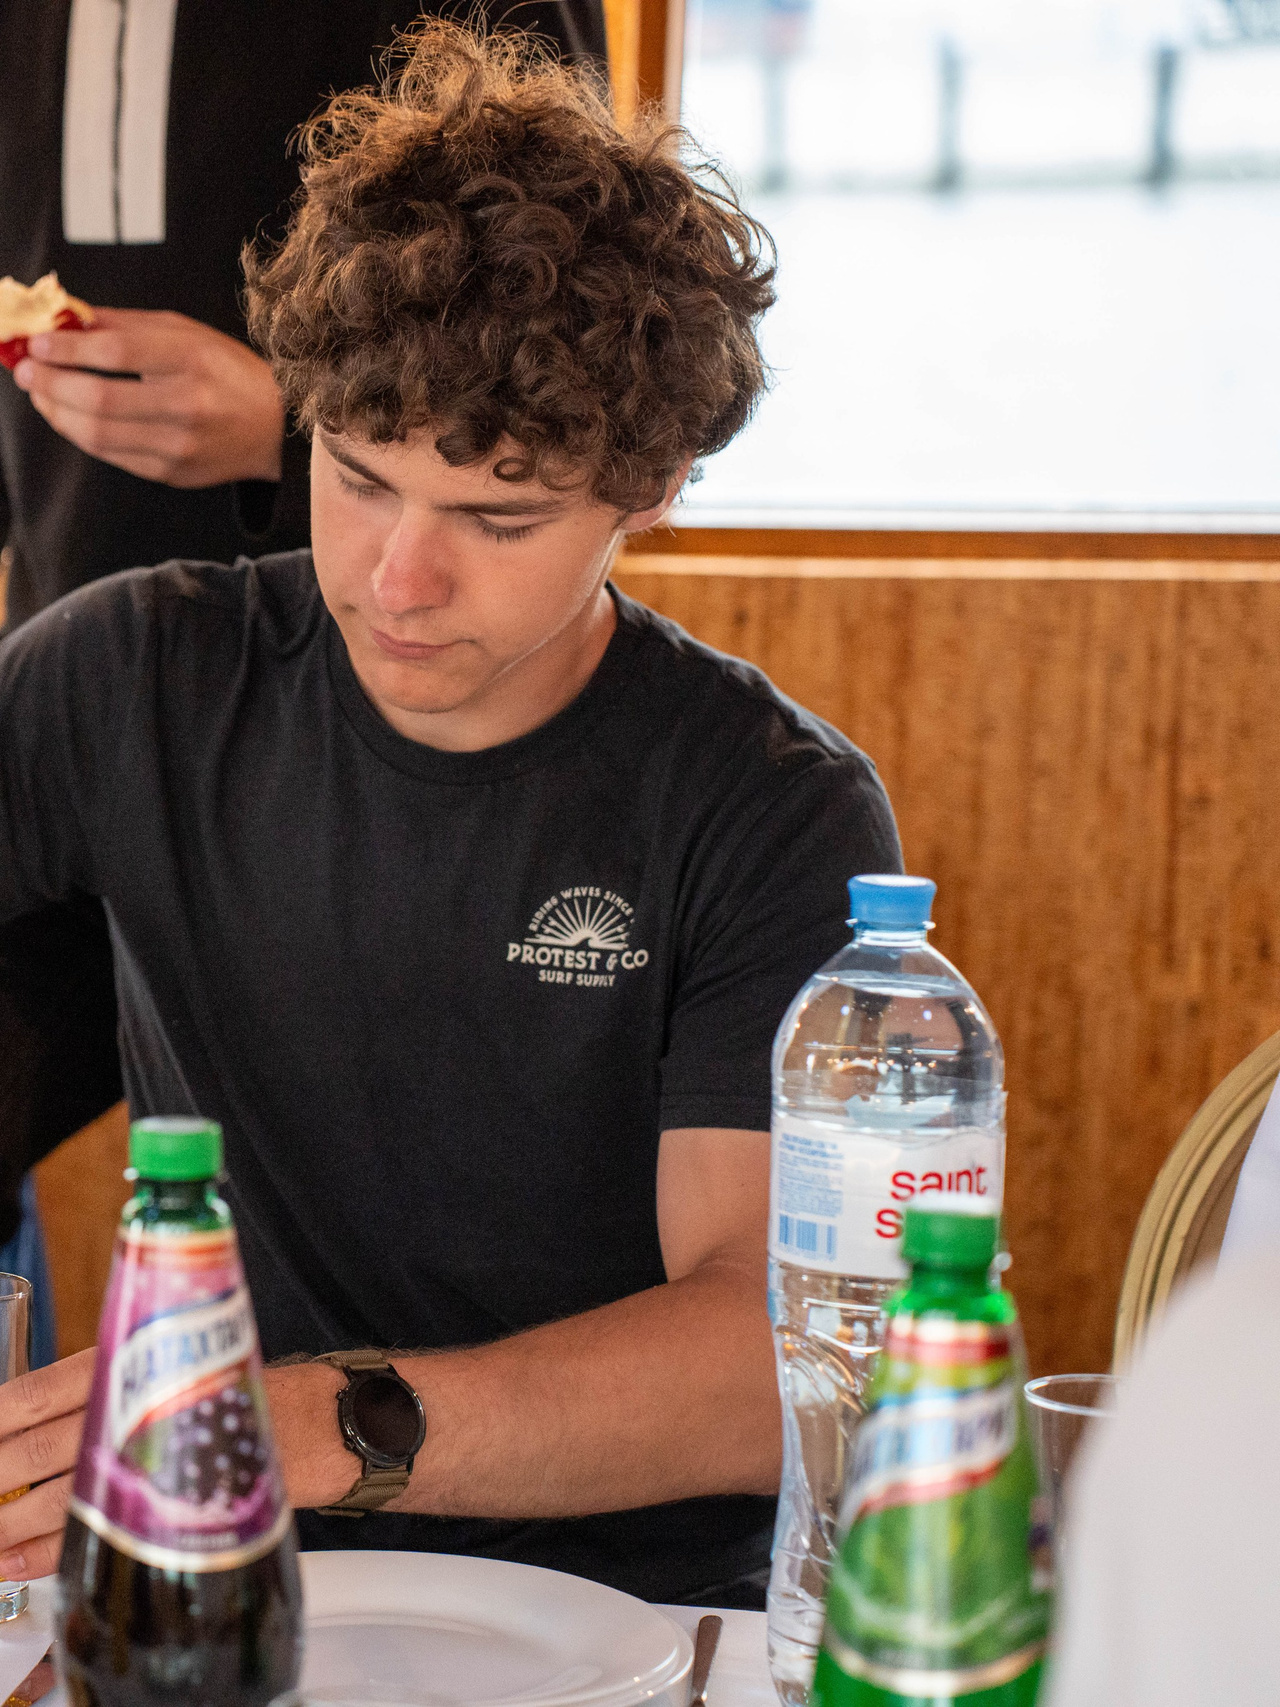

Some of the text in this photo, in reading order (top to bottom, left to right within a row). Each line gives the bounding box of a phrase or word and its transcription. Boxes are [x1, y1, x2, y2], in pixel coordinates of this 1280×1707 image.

[528, 886, 635, 932] RIDING WAVES SINCE
[506, 942, 649, 972] PROTEST & CO
[538, 969, 573, 985] SURF
